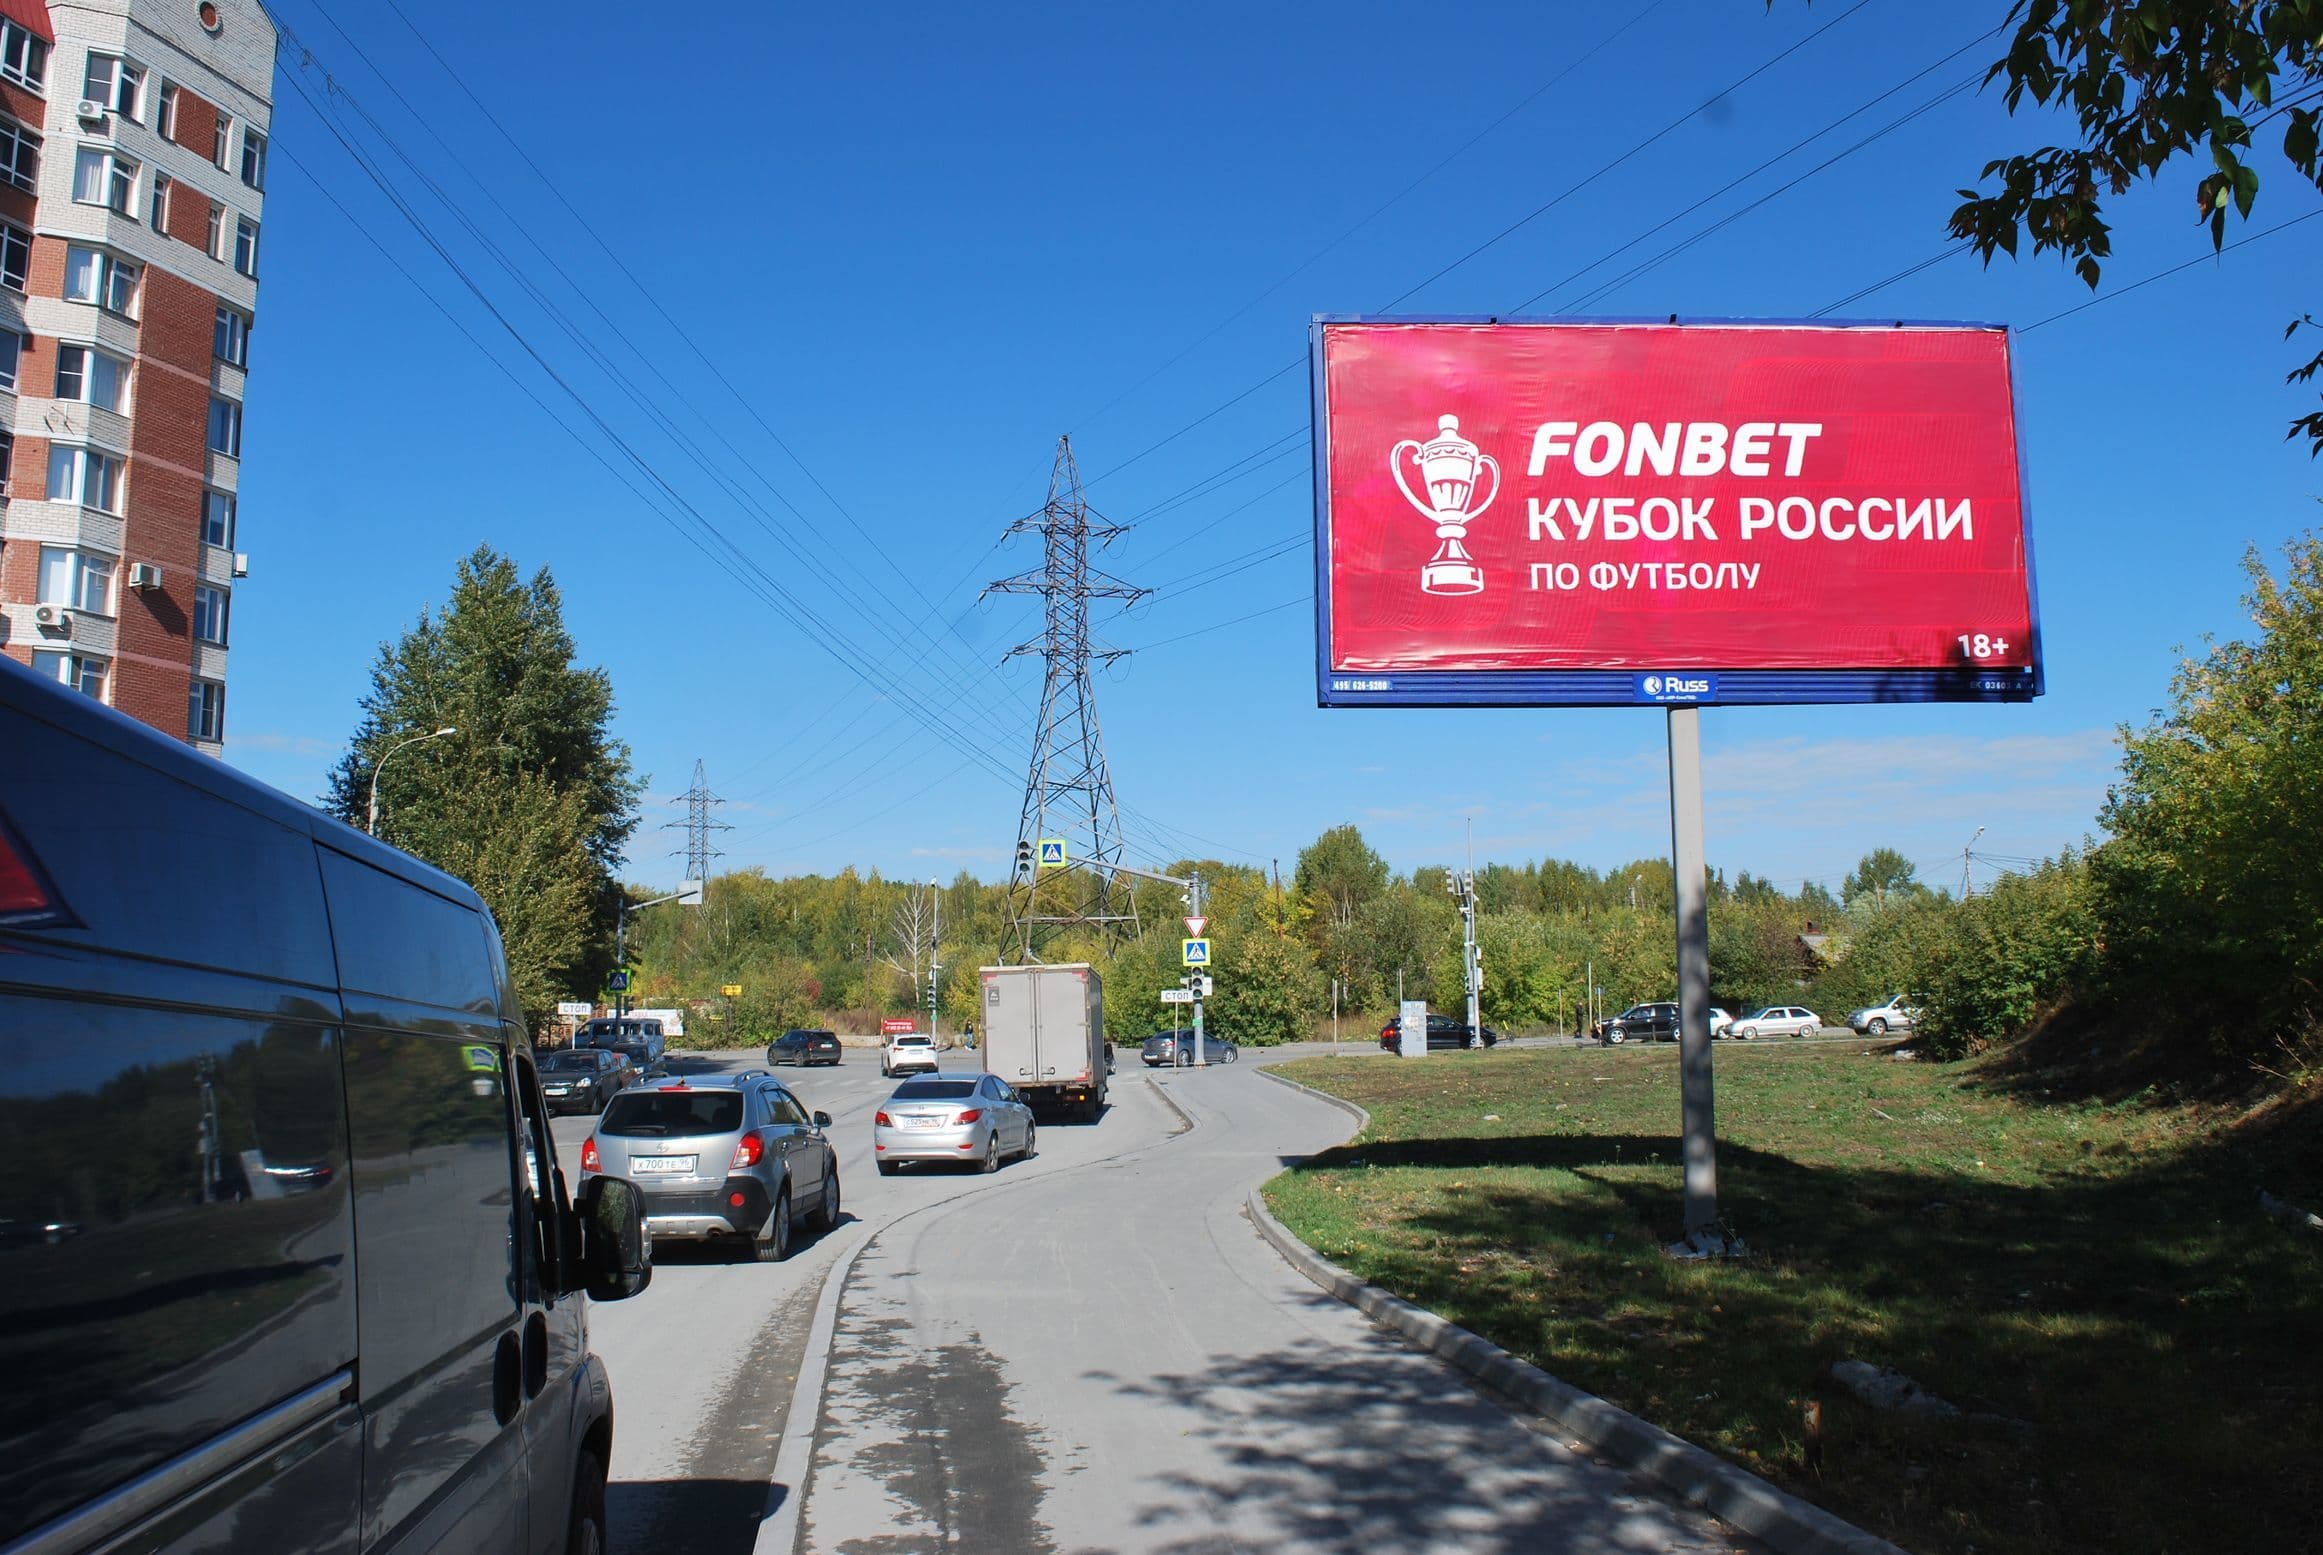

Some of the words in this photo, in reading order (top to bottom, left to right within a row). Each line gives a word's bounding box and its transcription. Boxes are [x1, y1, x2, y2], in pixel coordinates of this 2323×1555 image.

[1527, 421, 1823, 477] FONBET
[1527, 497, 1719, 541] КУБОК
[1739, 496, 1974, 541] РОССИИ
[1530, 562, 1580, 590] ПО
[1588, 561, 1761, 591] ФУТБОЛУ
[1957, 633, 2009, 658] 18+
[1665, 677, 1709, 693] Russ
[563, 1004, 588, 1013] СТОП
[1165, 992, 1189, 1000] СТОП
